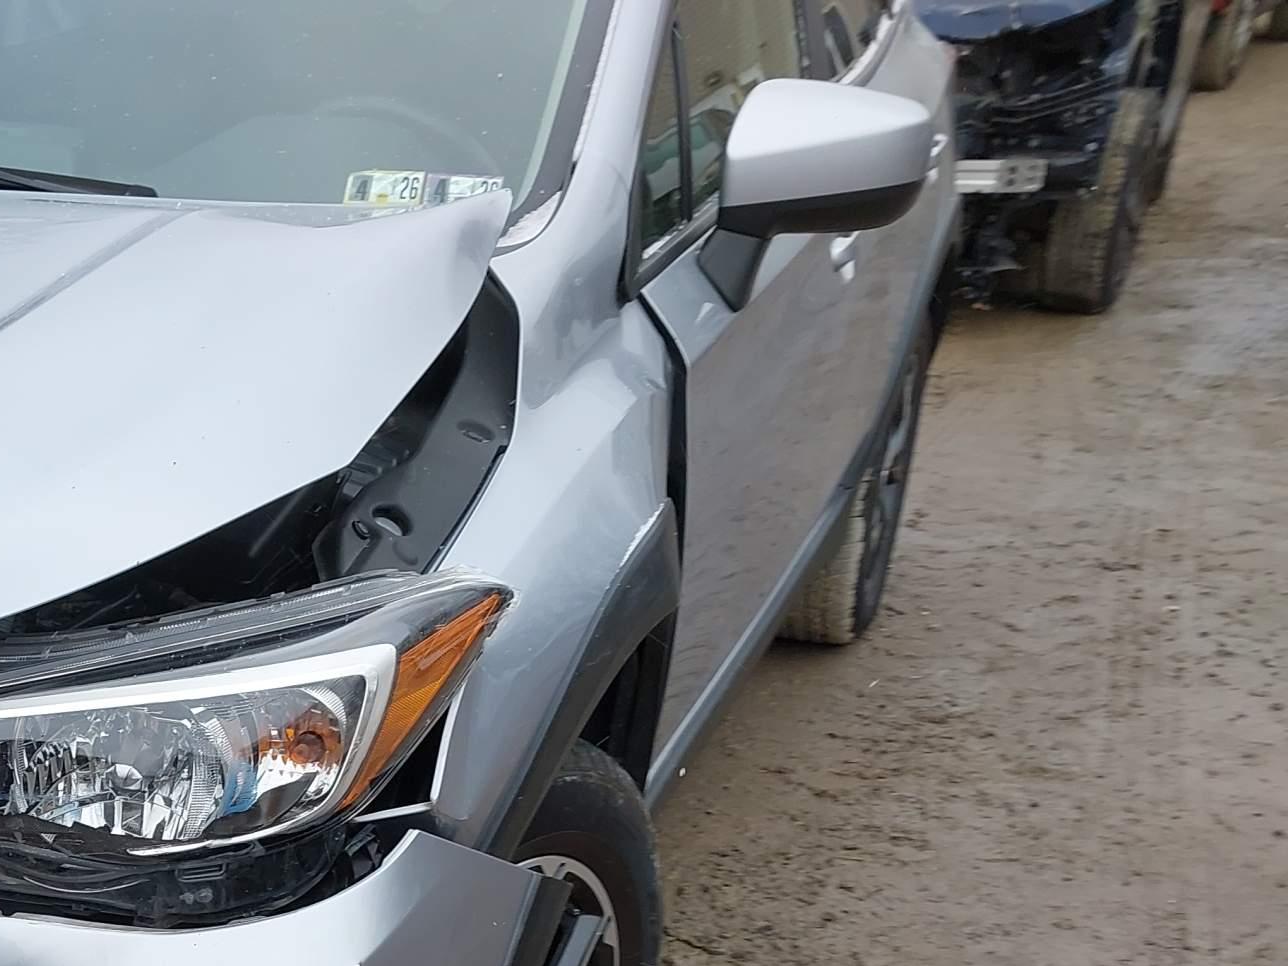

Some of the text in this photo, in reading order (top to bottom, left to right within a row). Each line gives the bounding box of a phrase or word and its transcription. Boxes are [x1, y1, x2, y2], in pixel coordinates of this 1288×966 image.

[354, 176, 421, 201] 4 26
[431, 178, 447, 203] 4
